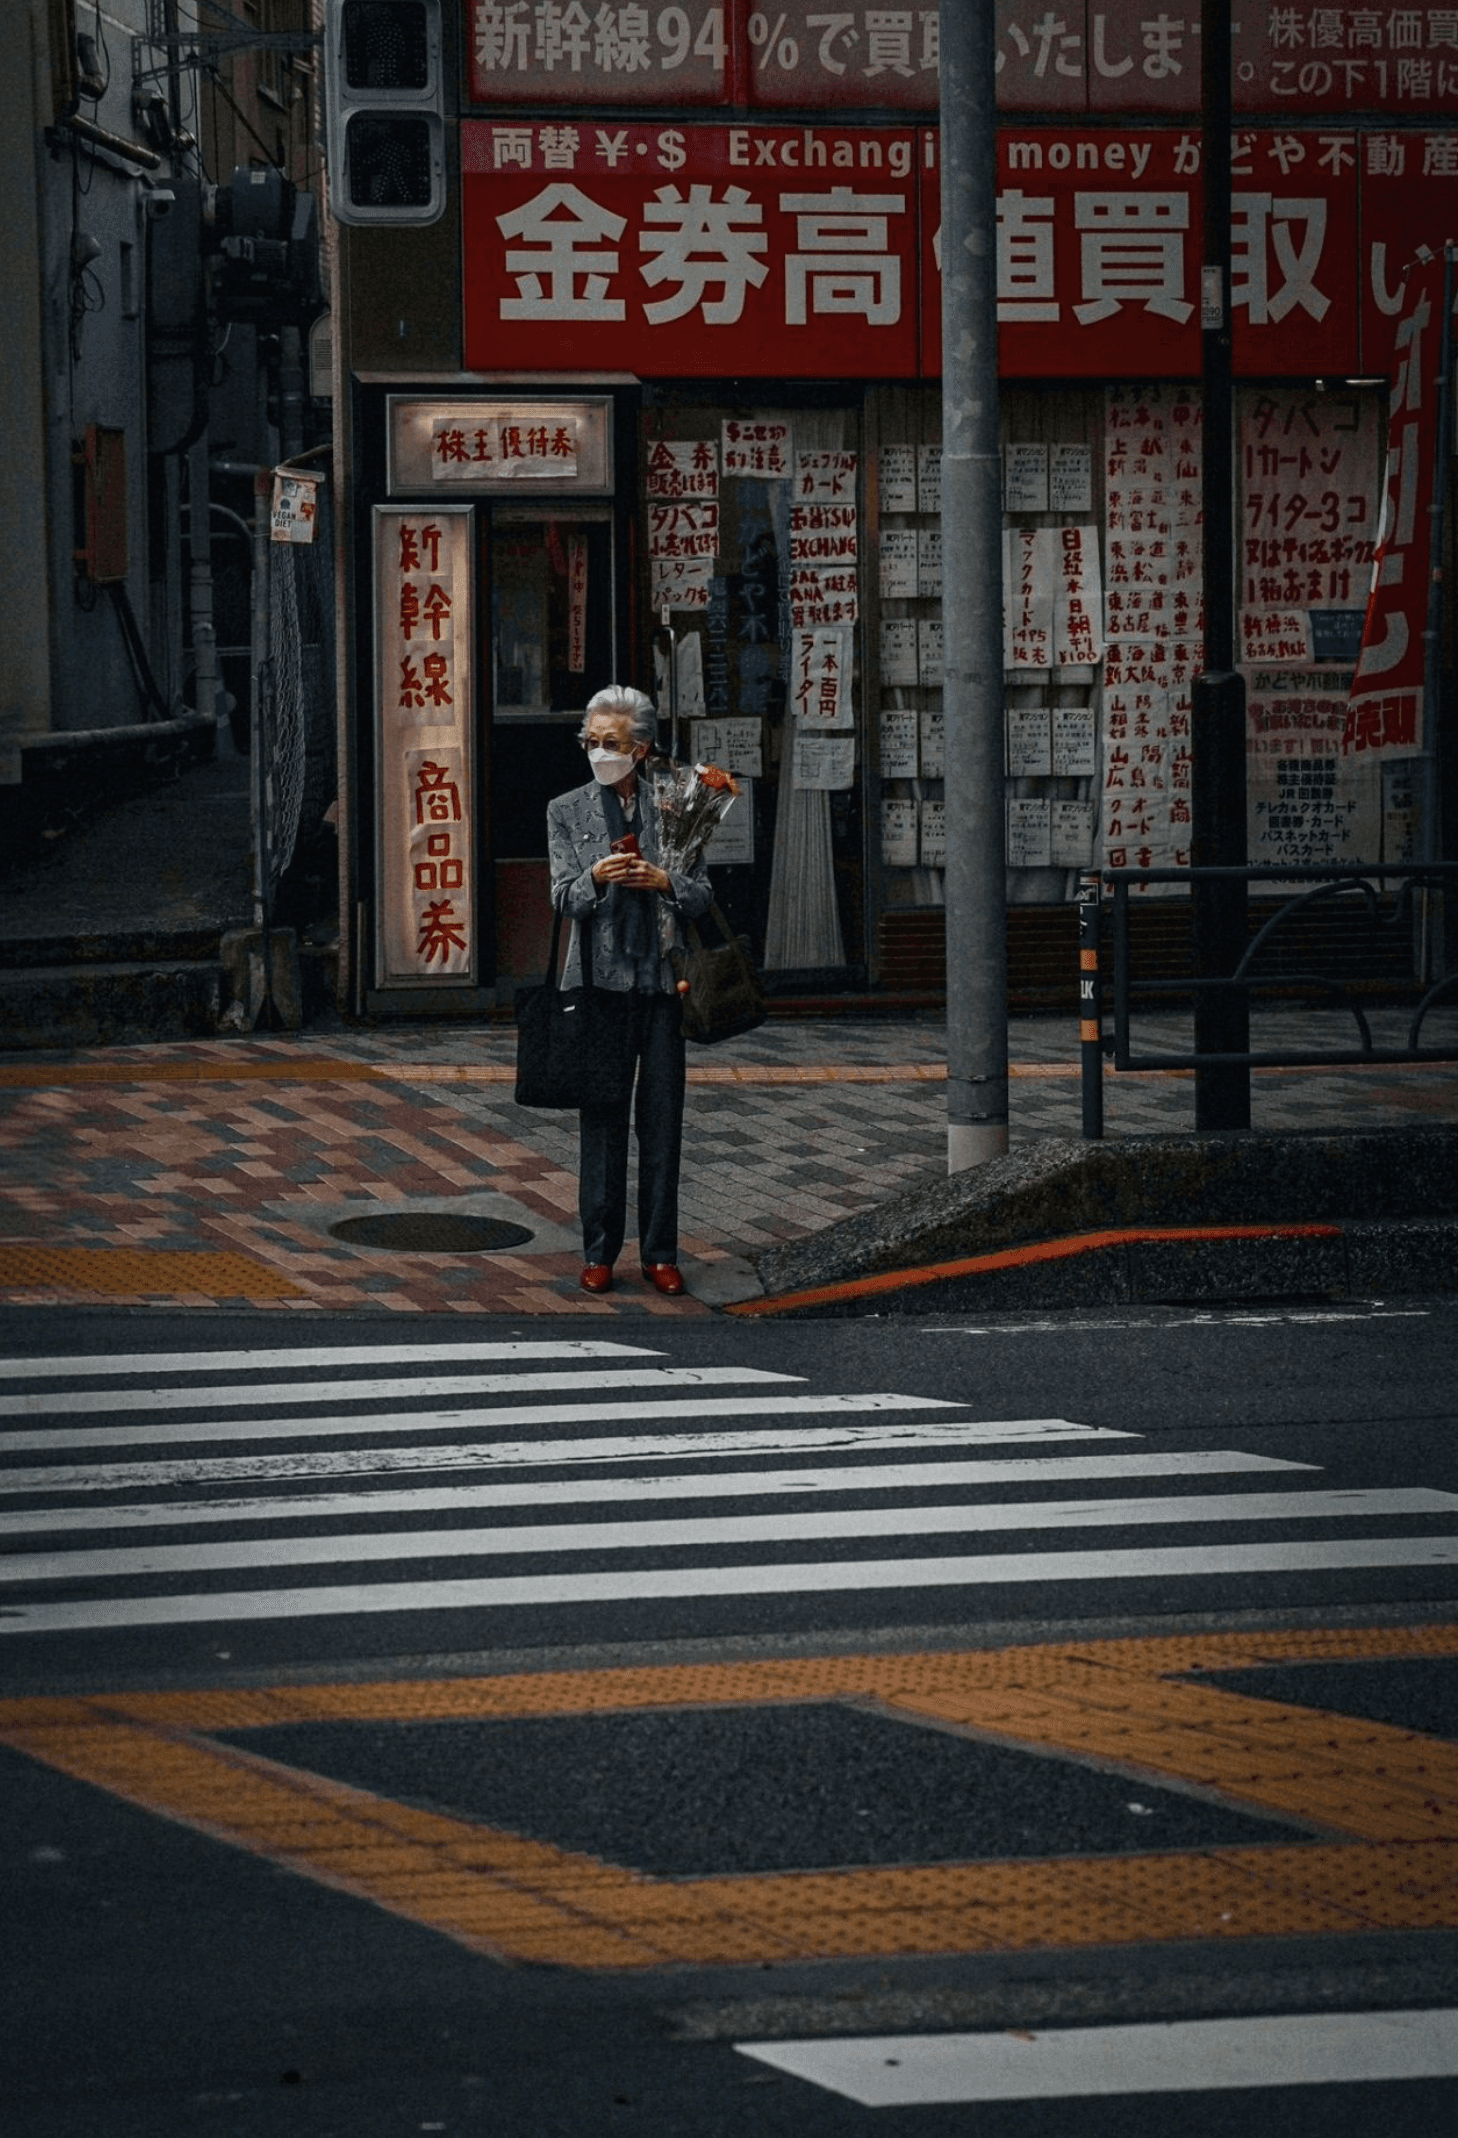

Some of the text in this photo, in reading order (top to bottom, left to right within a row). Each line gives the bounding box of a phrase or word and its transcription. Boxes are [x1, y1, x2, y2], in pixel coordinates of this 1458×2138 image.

[475, 2, 1254, 80] 新幹線94%で買いたしま。
[492, 127, 580, 169] 両替
[730, 130, 1152, 179] Exchangi money
[1173, 133, 1458, 176] かどや不動産
[495, 183, 1458, 324] 金券高値買取い
[1253, 396, 1360, 438] タバコ
[437, 427, 573, 462] 株主優待券
[652, 442, 714, 470] 金券
[802, 472, 845, 495] カード
[651, 504, 717, 531] タバコ
[660, 563, 701, 579] レター
[1019, 534, 1035, 626] マックカード
[796, 634, 814, 715] ライター
[1012, 646, 1047, 664] 販売
[819, 640, 838, 717] 一本百円
[399, 524, 466, 963] 新幹線 商品券
[1108, 815, 1154, 836] カード
